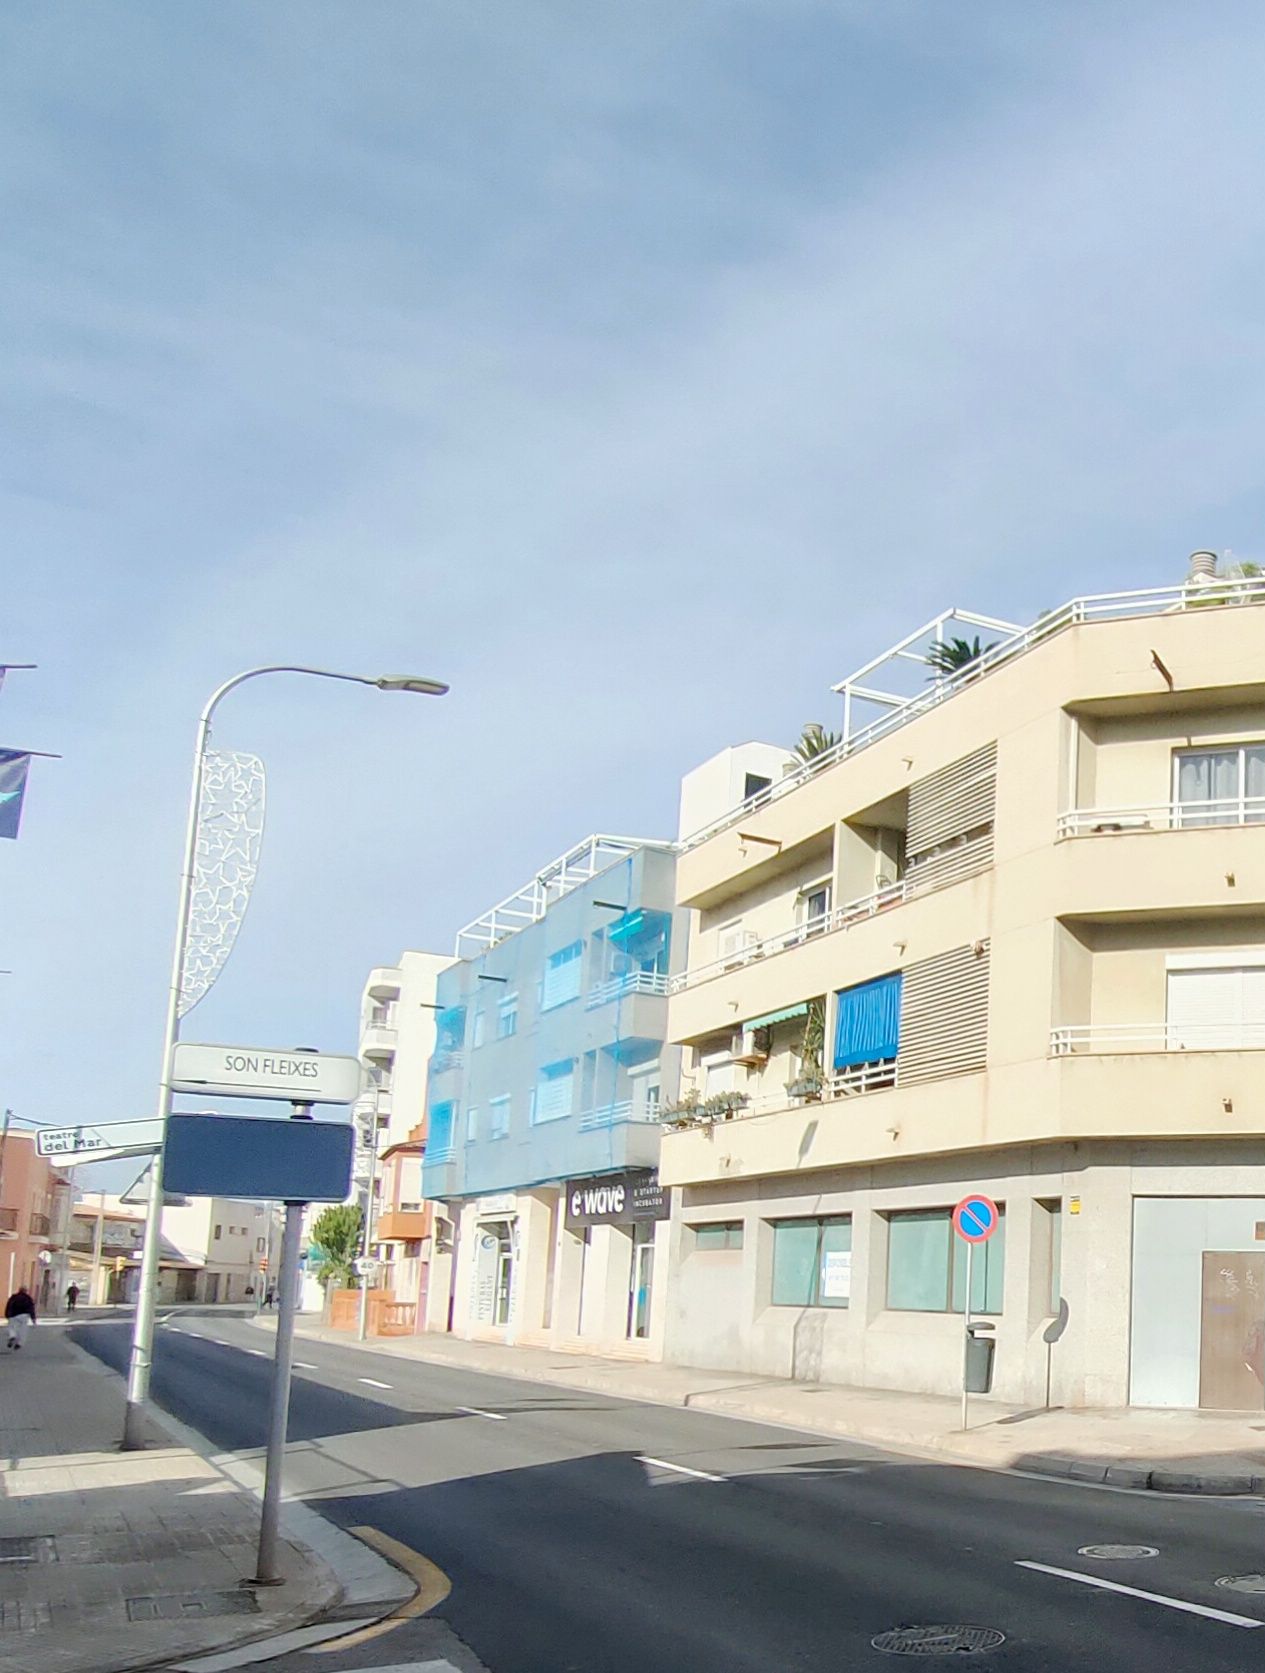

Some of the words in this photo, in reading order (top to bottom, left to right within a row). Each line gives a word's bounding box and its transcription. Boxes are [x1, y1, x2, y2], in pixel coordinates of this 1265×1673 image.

[225, 1055, 258, 1072] SON
[263, 1058, 319, 1078] FLEIXES
[45, 1140, 69, 1151] del
[75, 1139, 101, 1148] Mar
